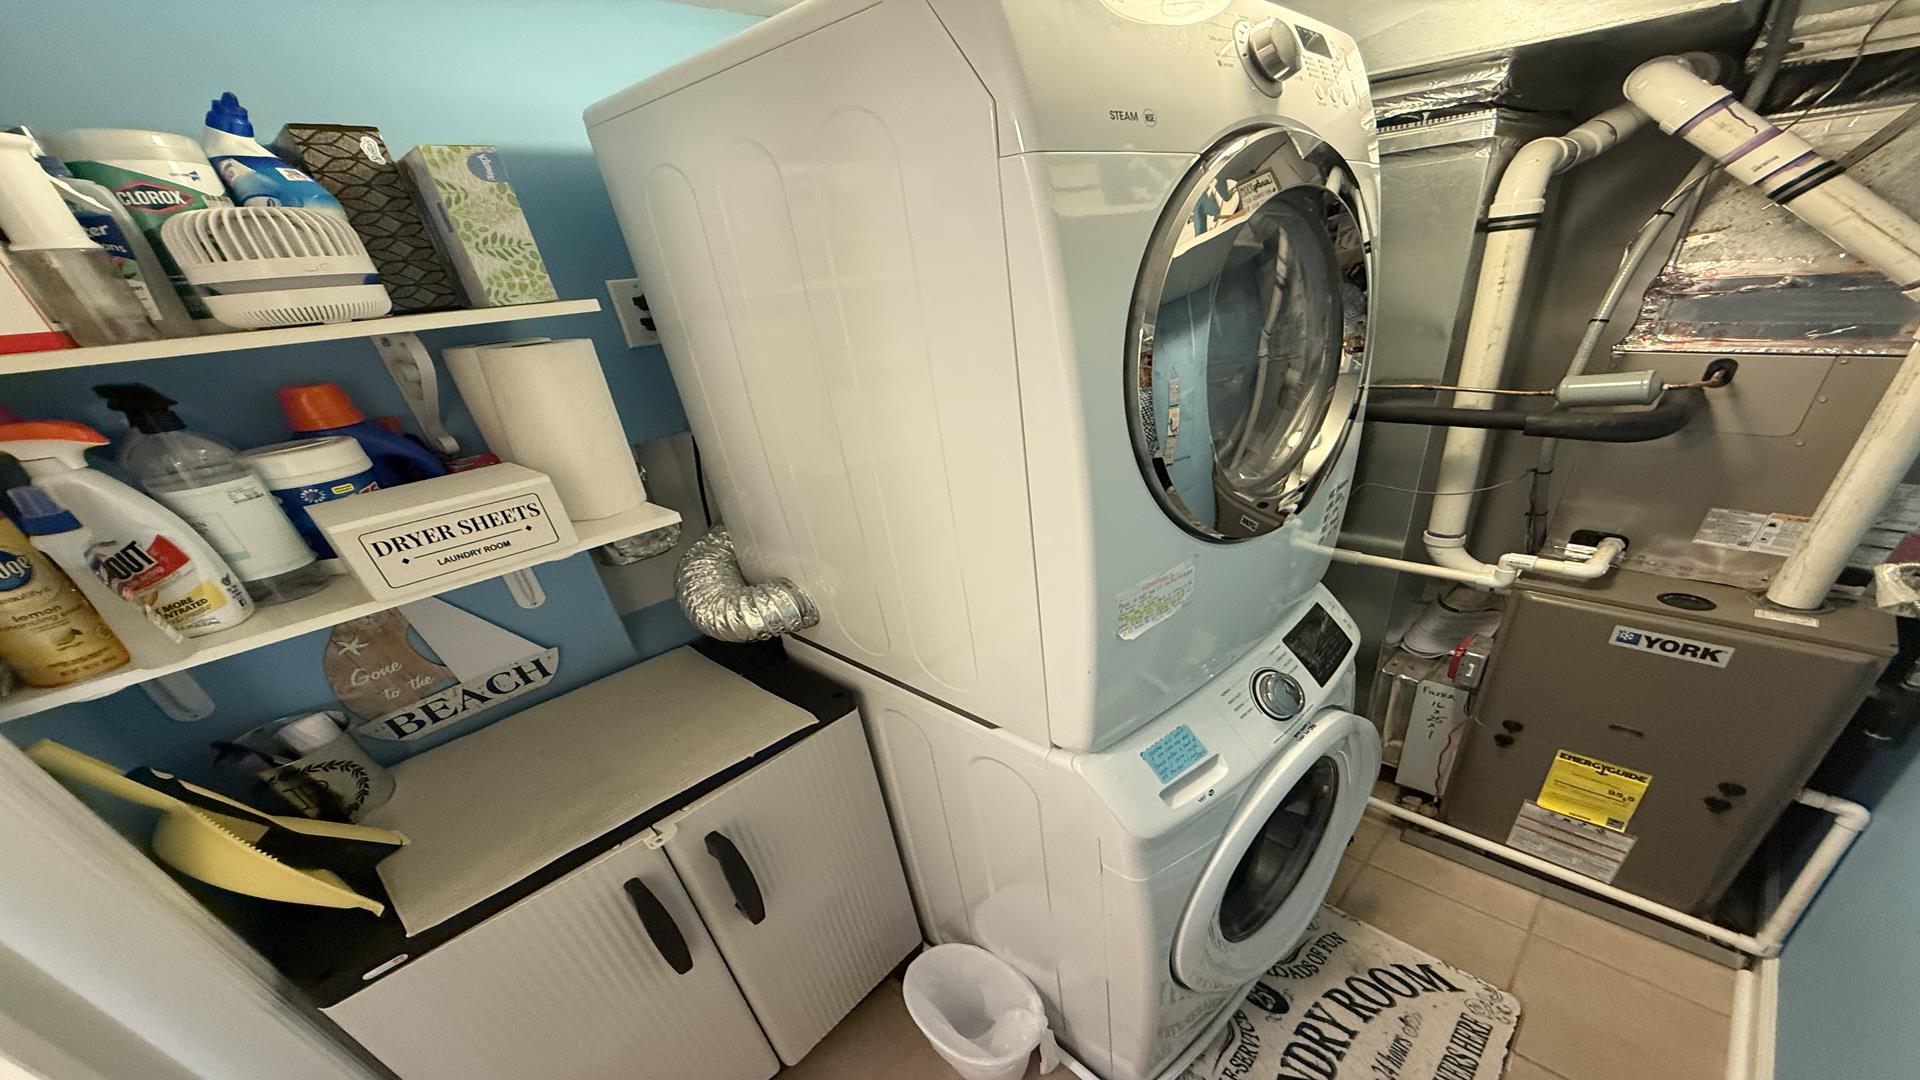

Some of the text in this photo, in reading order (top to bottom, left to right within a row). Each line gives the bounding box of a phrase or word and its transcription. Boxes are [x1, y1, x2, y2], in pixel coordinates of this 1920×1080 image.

[1109, 110, 1139, 121] STEAM
[116, 190, 187, 206] CLOROX
[370, 502, 541, 558] DRYER SHEETS
[437, 540, 512, 566] LAUNDRY ROOM
[12, 605, 62, 622] lemon
[161, 596, 193, 613] MORE
[164, 599, 208, 619] NTRATED
[1644, 635, 1724, 663] YORK
[350, 661, 402, 687] Gone
[383, 674, 434, 699] to the
[384, 657, 553, 740] BEACH
[1315, 931, 1348, 954] FUN
[1306, 946, 1329, 966] OF
[1322, 963, 1466, 1023] ROOM
[1449, 1012, 1493, 1059] HERE
[1376, 1033, 1413, 1070] hours
